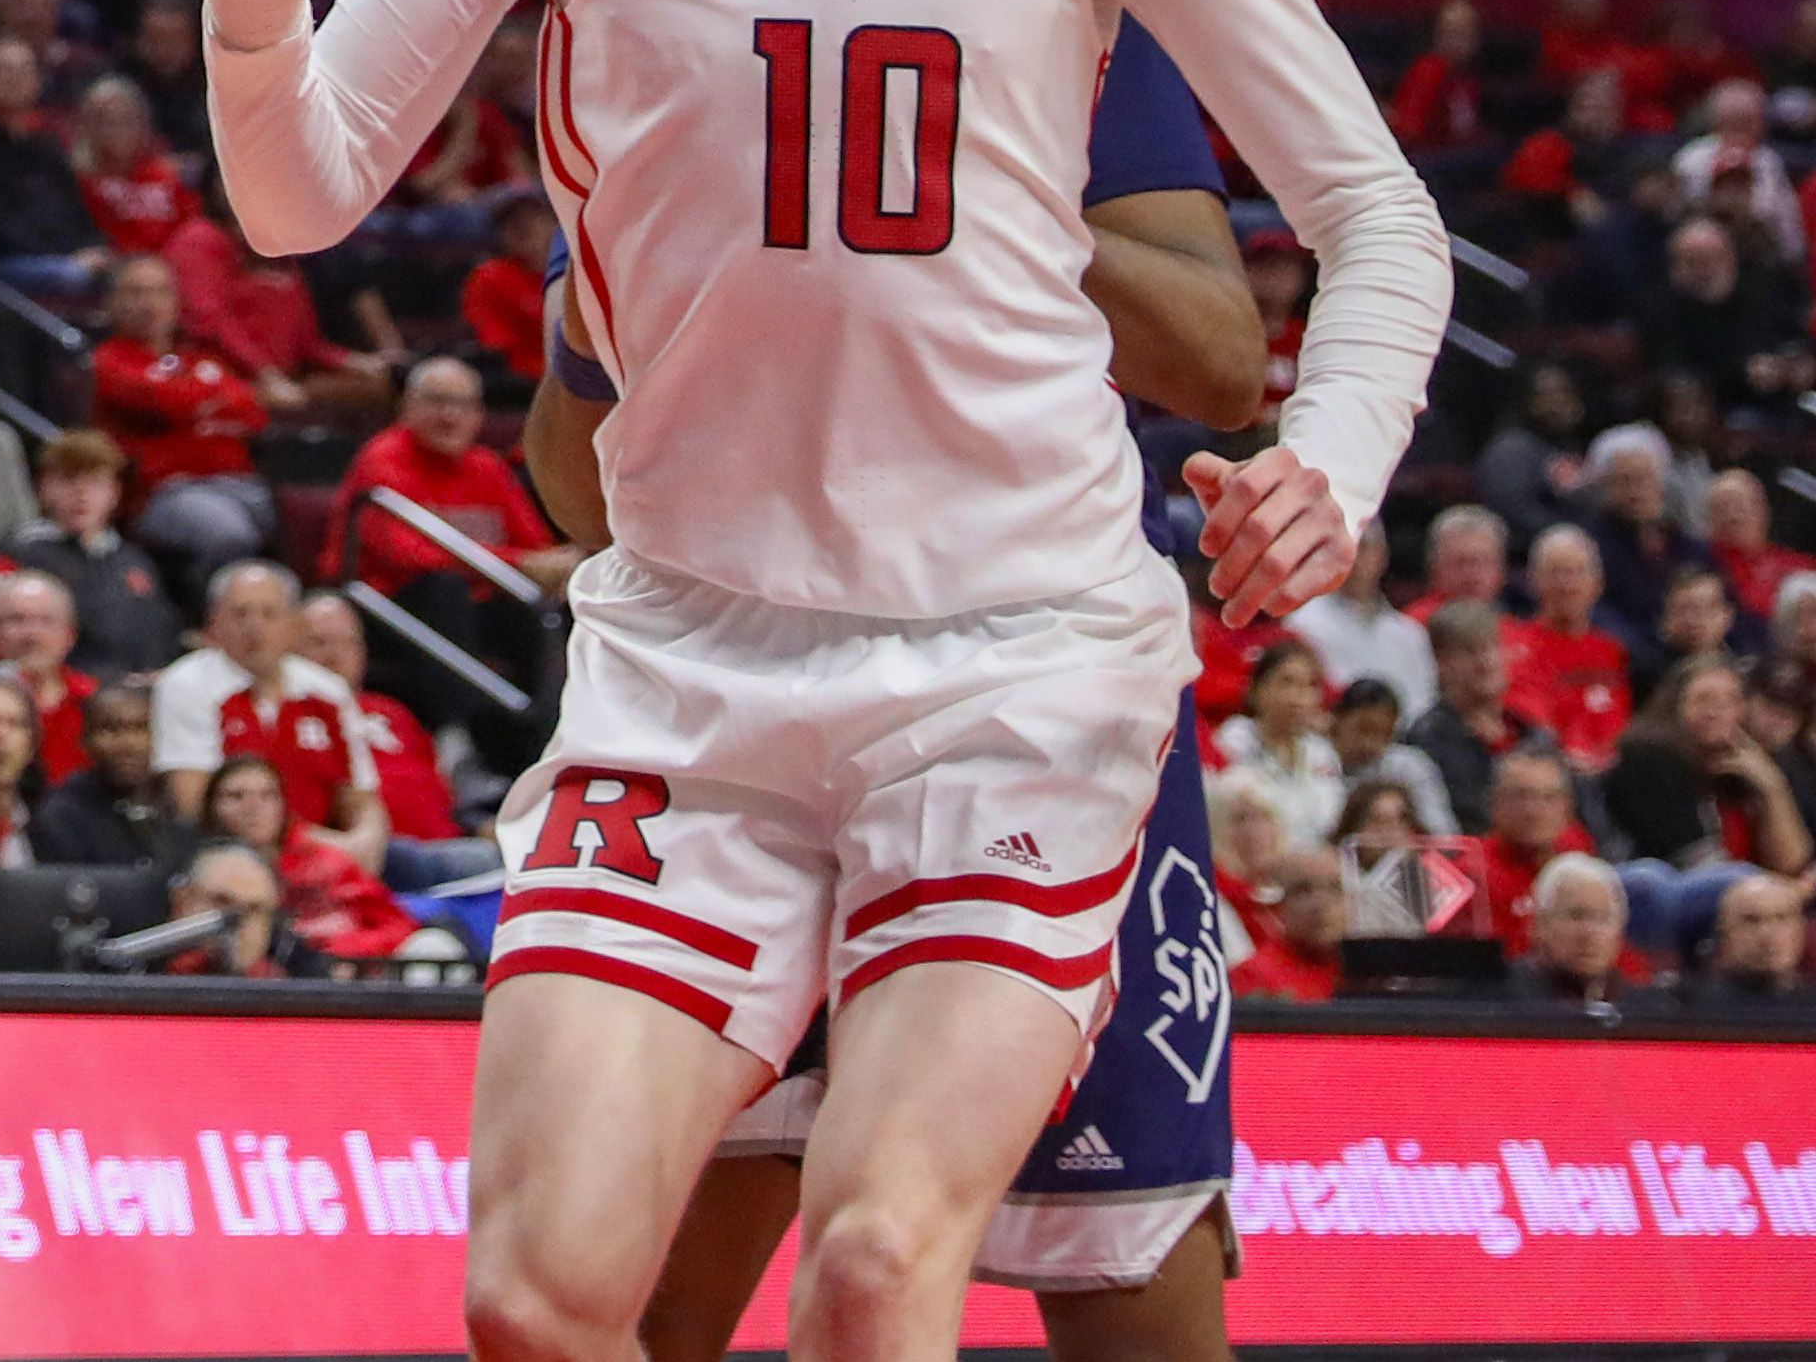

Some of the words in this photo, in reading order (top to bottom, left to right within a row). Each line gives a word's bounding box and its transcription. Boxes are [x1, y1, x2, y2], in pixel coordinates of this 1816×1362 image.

[752, 18, 963, 256] 10
[519, 765, 670, 886] R
[984, 846, 1052, 872] adidas
[32, 1127, 196, 1236] New
[197, 1129, 347, 1236] Life
[1056, 1155, 1125, 1171] adidas
[1498, 1138, 1643, 1236] New
[1629, 1139, 1761, 1236] Life
